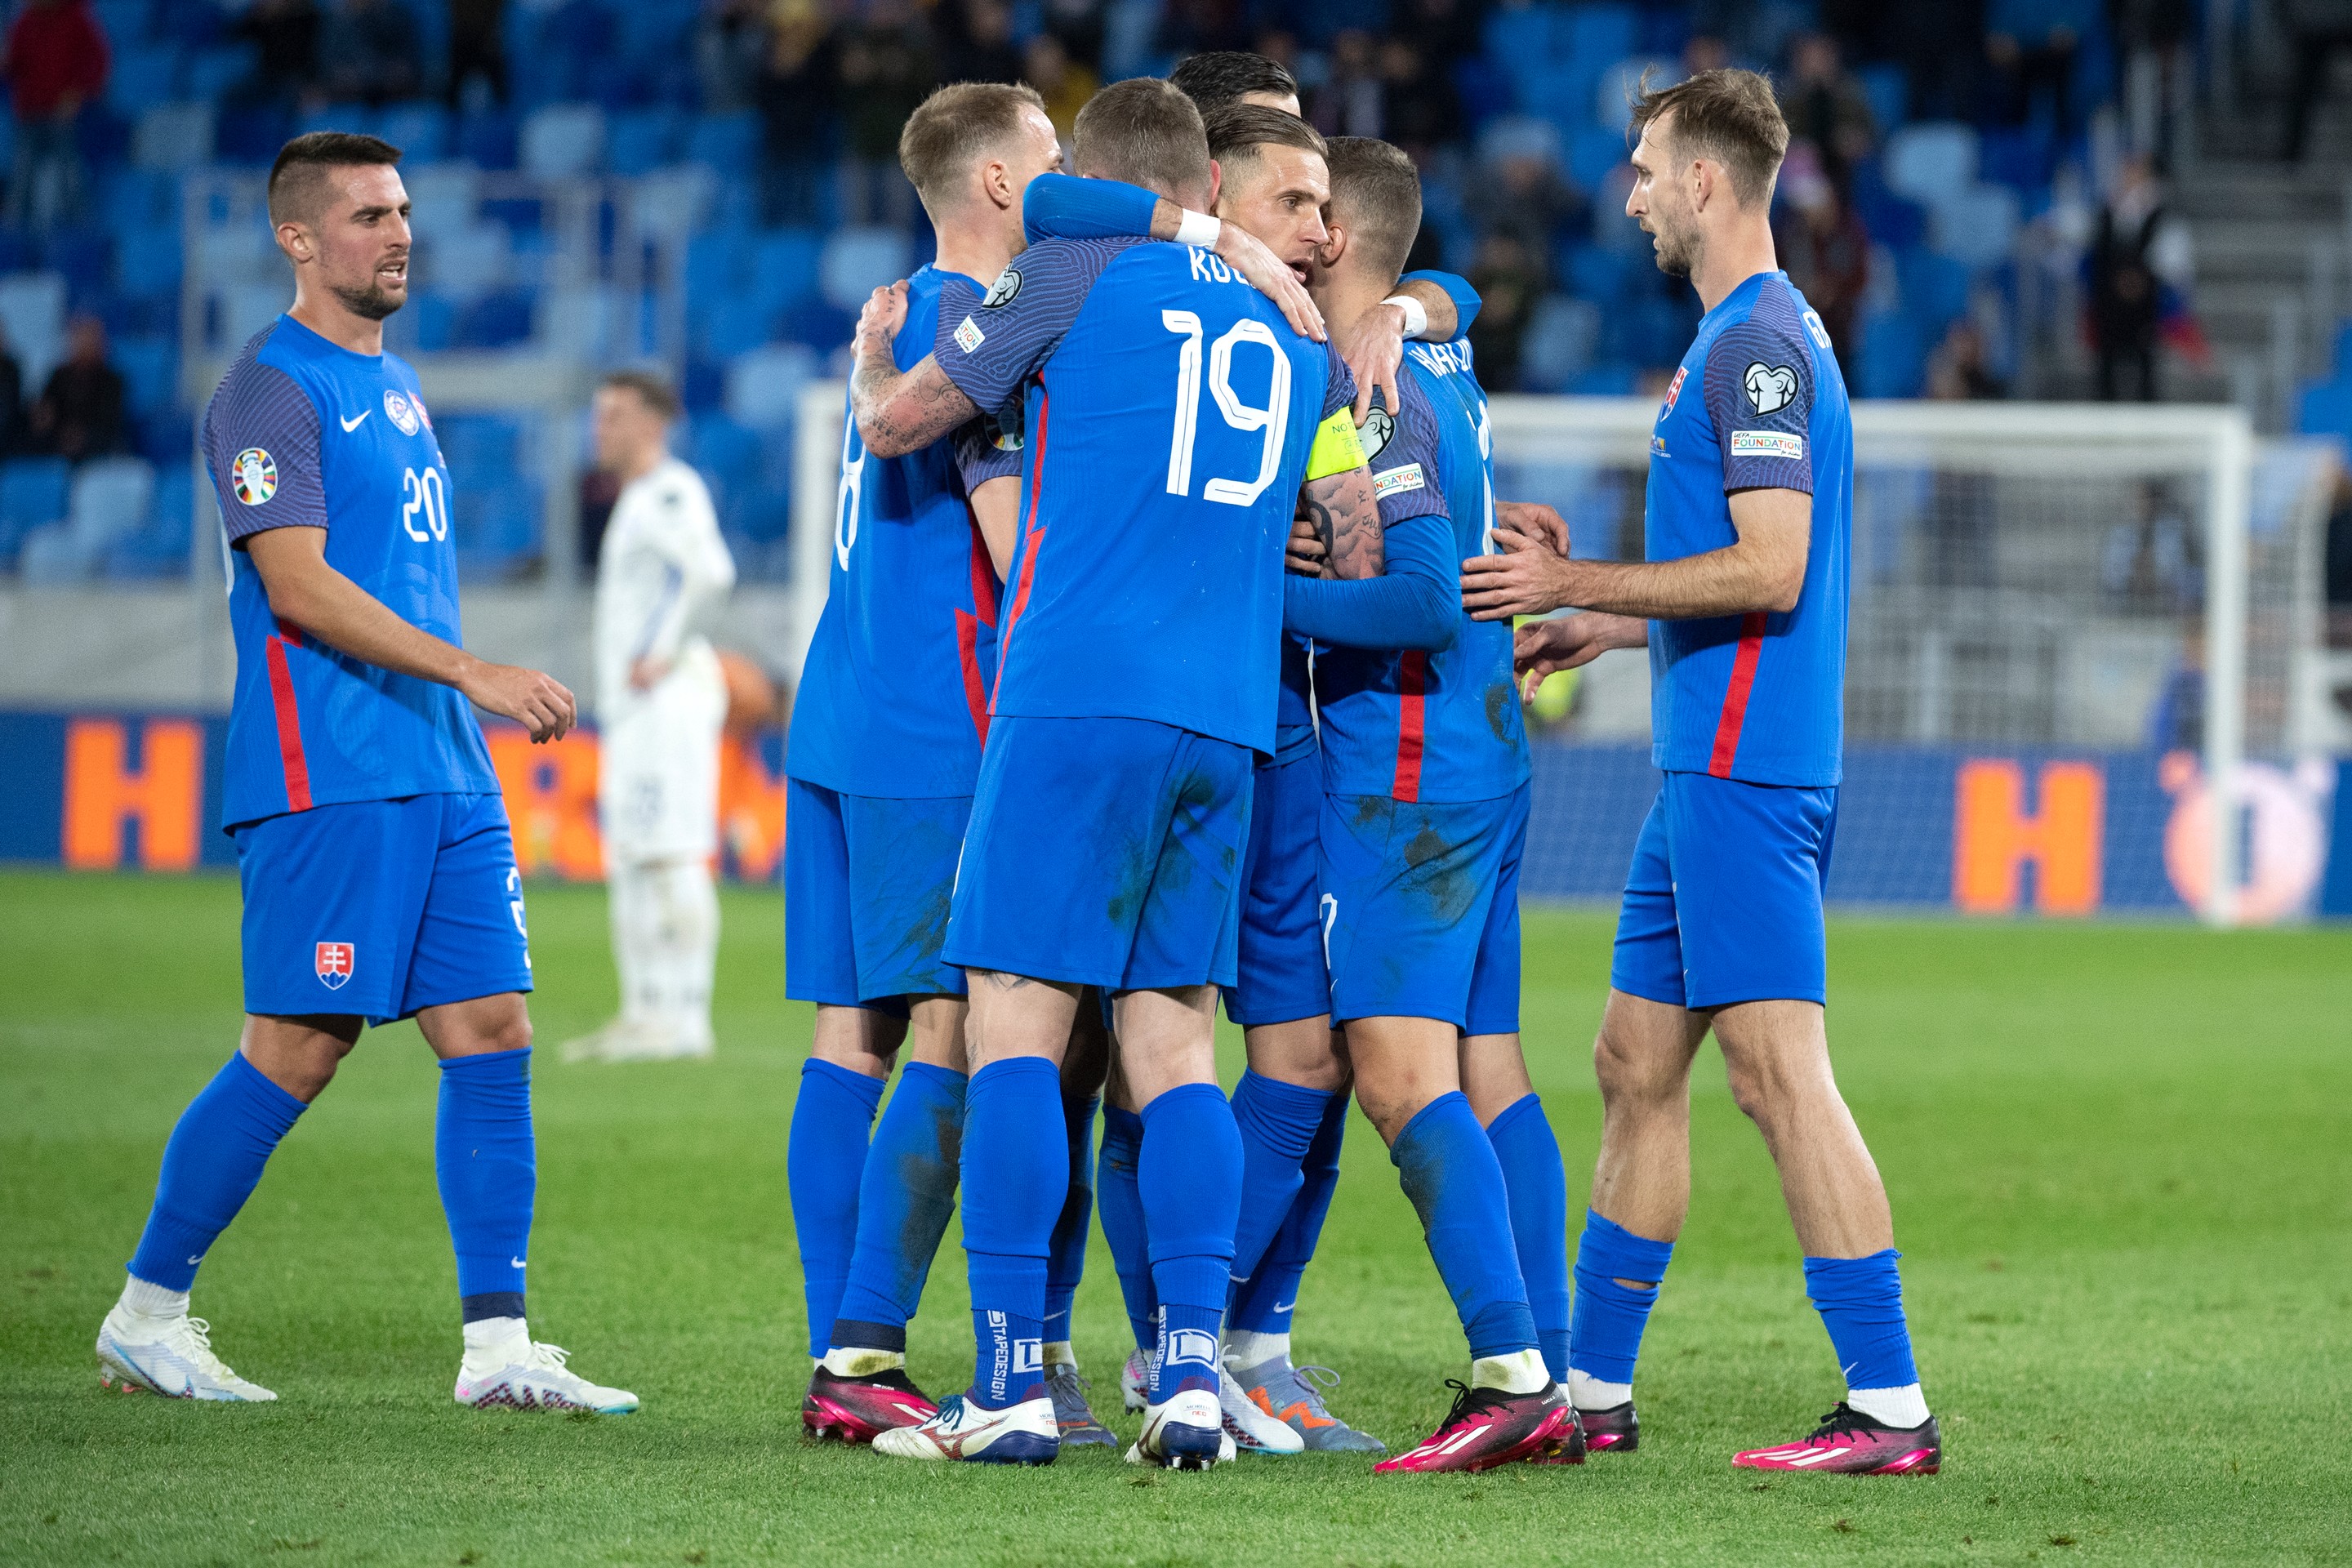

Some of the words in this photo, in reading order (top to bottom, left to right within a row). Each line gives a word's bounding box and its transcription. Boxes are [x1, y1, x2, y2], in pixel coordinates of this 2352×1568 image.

[1162, 309, 1292, 507] 19
[1733, 439, 1801, 451] FOUNDATION
[403, 466, 448, 542] 20
[991, 1326, 1009, 1401] TAPEDESIGN
[1149, 1321, 1167, 1392] TAPEDESIGN
